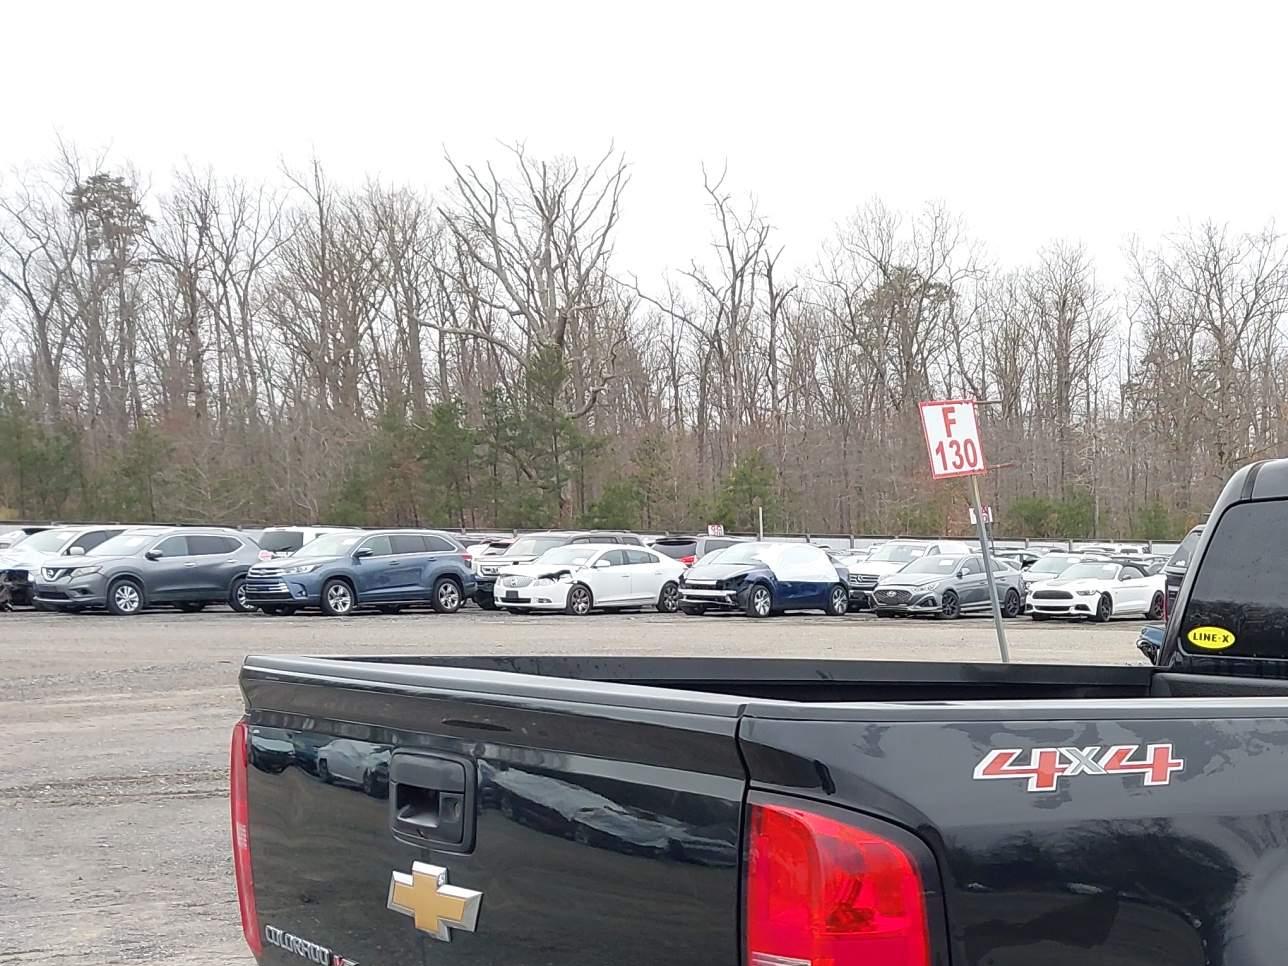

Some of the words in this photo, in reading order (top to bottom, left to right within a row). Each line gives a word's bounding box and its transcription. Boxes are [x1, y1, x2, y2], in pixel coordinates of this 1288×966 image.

[942, 406, 956, 438] F
[935, 438, 978, 471] 130
[265, 924, 330, 966] COLORADO
